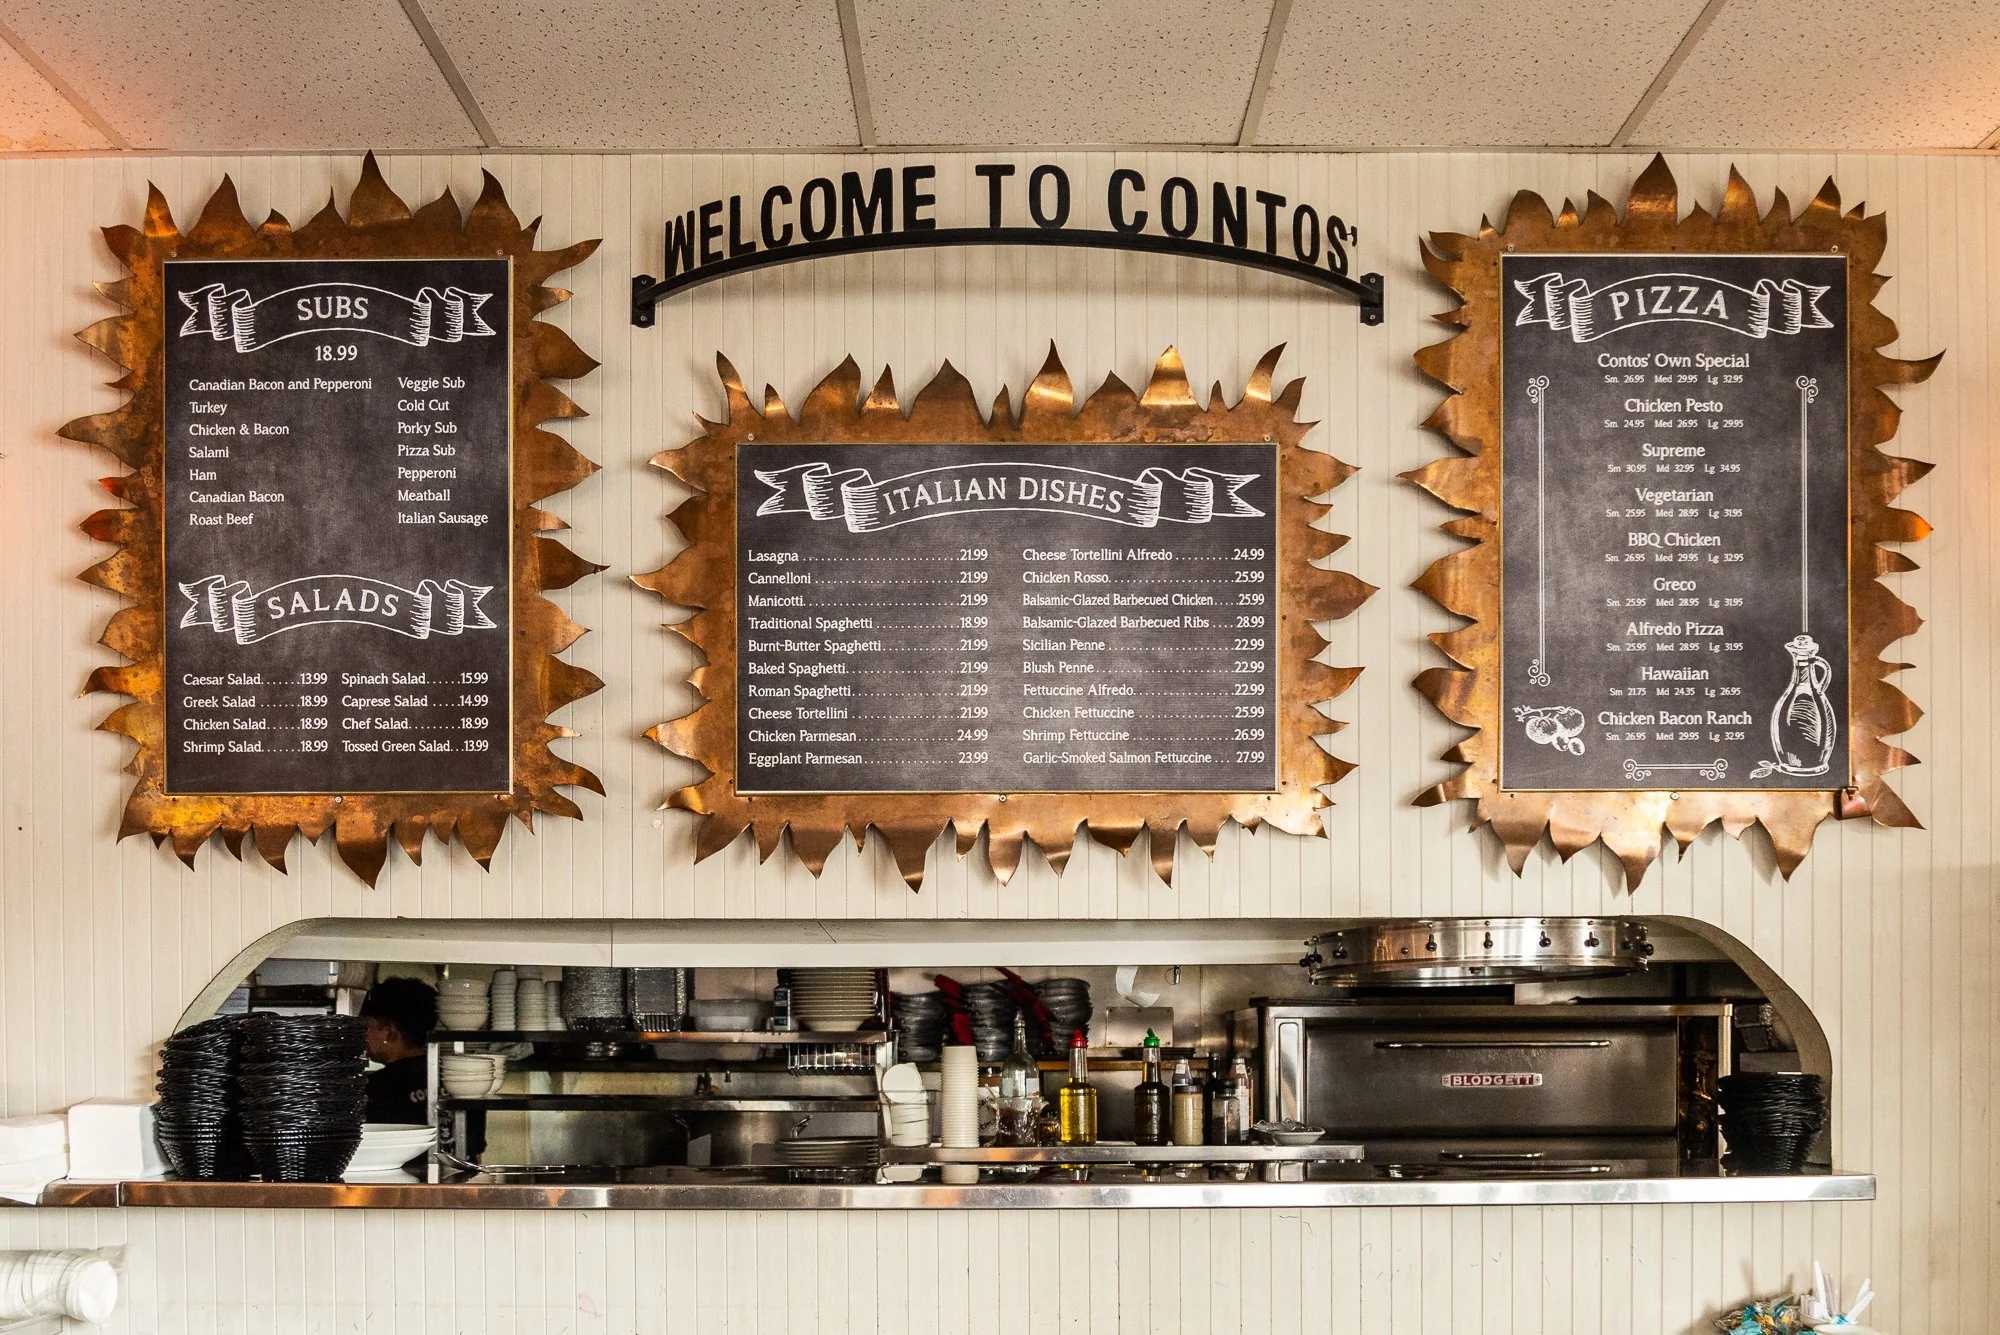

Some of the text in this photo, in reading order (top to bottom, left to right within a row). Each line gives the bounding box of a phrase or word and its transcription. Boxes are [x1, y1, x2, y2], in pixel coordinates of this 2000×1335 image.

[664, 165, 937, 279] WELCOME
[975, 164, 1071, 230] TO
[297, 296, 369, 321] SUBS
[1609, 286, 1729, 321] PIZZA
[315, 345, 357, 361] 18.99
[1654, 353, 1691, 367] Own
[1695, 353, 1750, 371] Special
[189, 378, 372, 392] Canadian Bacon and Pepperoni
[398, 376, 465, 392] Veggie Sub
[1654, 375, 1672, 383] Med
[1708, 375, 1719, 385] Lg
[189, 401, 227, 416] Turkey
[398, 399, 449, 411] Cold Cut
[1624, 398, 1723, 412] Chicken Pesto
[189, 423, 289, 436] Chicken & Bacon
[398, 422, 457, 436] Porky Sub
[189, 446, 229, 458] Salami
[398, 444, 456, 456] Pizza Sub
[1642, 443, 1705, 460] Supreme
[190, 469, 216, 480] Ham
[398, 467, 456, 482] Pepperoni
[1656, 464, 1669, 472] Md
[1704, 464, 1715, 475] Lg
[189, 490, 284, 503] Canadian Bacon
[398, 489, 450, 501] Meatball
[883, 476, 1126, 515] ITALIAN DISHES
[1635, 488, 1713, 506] Vegetarian
[190, 513, 254, 525] Roast Beef
[398, 512, 488, 526] Italian Sausage
[1628, 532, 1721, 548] BBQ Chicken
[748, 549, 988, 565] Lasagna 21.99
[1023, 548, 1264, 561] Cheese Tortellini Alfredo 24.99
[748, 571, 988, 584] Cannelloni 21.99
[1023, 571, 1264, 583] Chicken Rosso 25.99
[1653, 577, 1696, 591] Greco
[267, 588, 399, 619] SALADS
[748, 594, 988, 607] Manicotti 21.99
[1023, 593, 1265, 606] Balsamic-Glazed Barbecued Chicken 25.99
[748, 616, 988, 632] Traditional Spaghetti 18.99
[1023, 616, 1264, 628] Balsamic-Glazed Barbecued Ribs 28.99
[1626, 621, 1724, 636] Alfredo Pizza
[748, 639, 988, 654] Burnt-Butter Spaghetti 21.99
[748, 661, 988, 677] Baked Spaghetti 21.99
[1641, 666, 1709, 680] Hawaiian
[183, 673, 328, 685] Caesar Salad 13.99
[342, 672, 488, 687] Spinach Salad 15.99
[1023, 684, 1265, 696] Fettuccine Alfredo 22.99
[1656, 688, 1669, 696] Md
[1705, 687, 1716, 698] Lg
[183, 695, 328, 708] Greek Salad 18.99
[342, 695, 488, 710] Caprese Salad 14.99
[1023, 706, 1264, 718] Chicken Fettuccine 25.99
[1598, 711, 1752, 725] Chicken Bacon Ranch
[183, 718, 328, 730] Chicken Salad 18.99
[342, 717, 488, 729] Chef Salad 18.99
[749, 729, 988, 742] Chicken Parmesan 24.99
[1023, 728, 1265, 744] Shrimp Fettuccine 26.99
[1656, 732, 1674, 740] Med
[1709, 732, 1720, 742] Lg
[184, 740, 328, 755] Shrimp Salad 18.99
[342, 740, 489, 752] Tossed Green Salad 13.99
[749, 751, 988, 767] Eggplant Parmesan 23.99
[1023, 751, 1265, 764] Garlic-Smoked Salmon Fettuccine 27.99
[1453, 1075, 1532, 1086] BLODGETT
